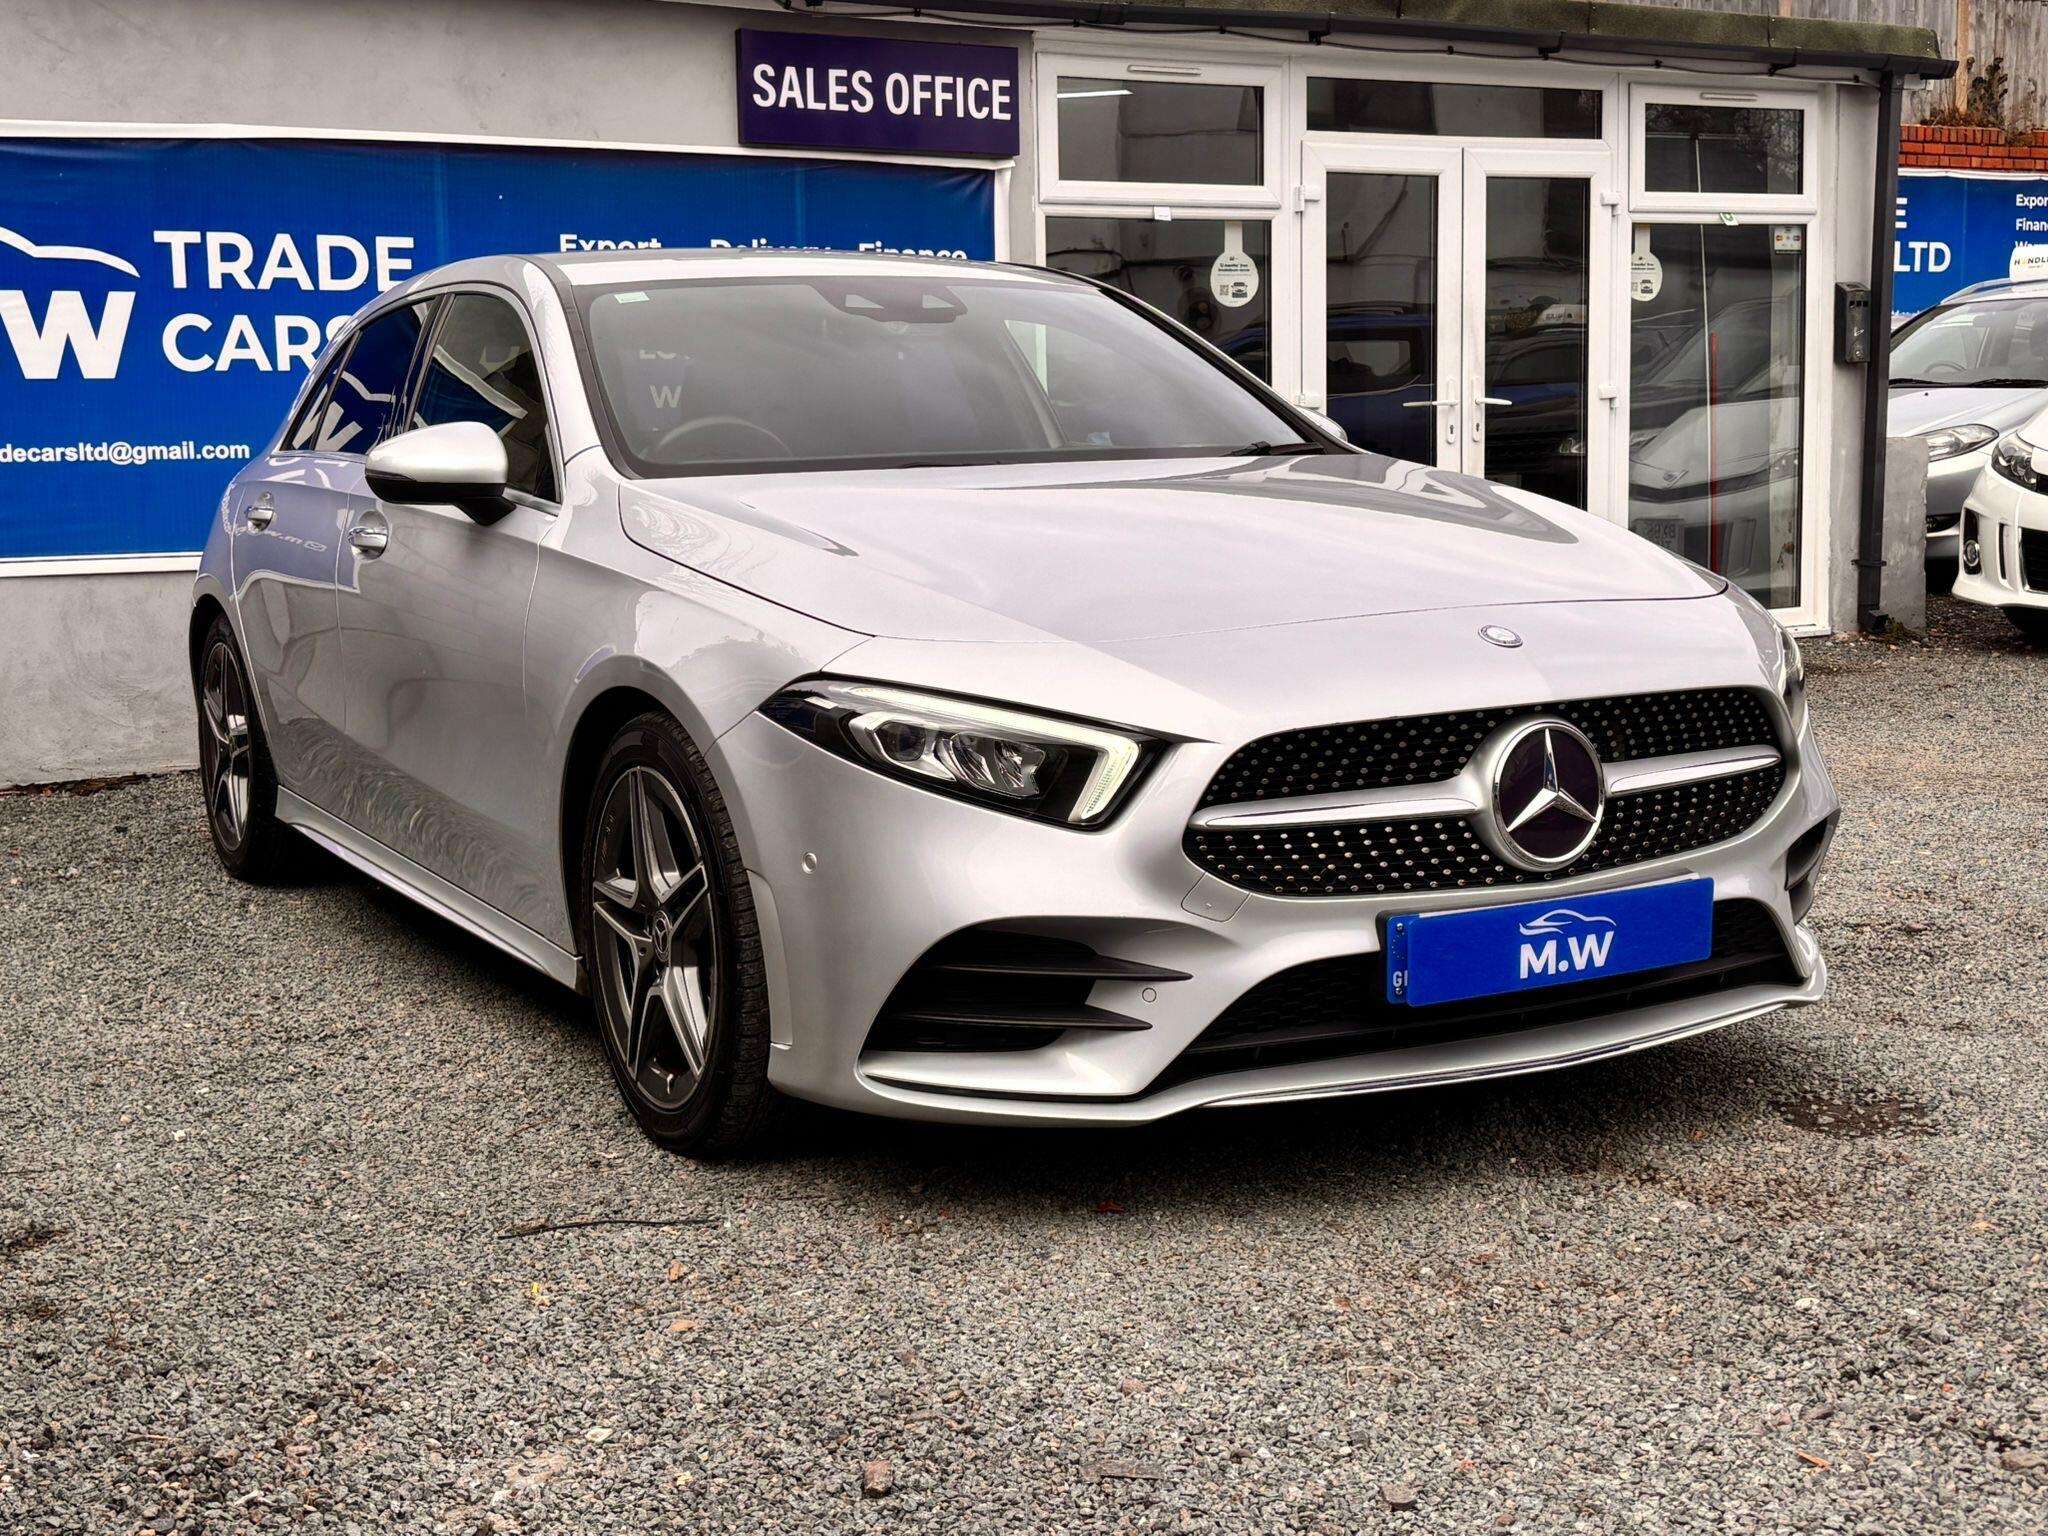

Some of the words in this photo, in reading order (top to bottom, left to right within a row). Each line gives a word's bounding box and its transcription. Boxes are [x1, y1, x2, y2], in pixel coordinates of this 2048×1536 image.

[752, 63, 874, 114] SALES
[885, 72, 1012, 121] OFFICE
[153, 230, 415, 292] TRADE
[1893, 240, 1951, 272] LTD
[2014, 256, 2048, 266] HNDL
[162, 313, 353, 373] CAR
[0, 441, 250, 465] decarsltd@gmail.com
[1520, 930, 1615, 979] M.W
[1392, 970, 1409, 988] G
